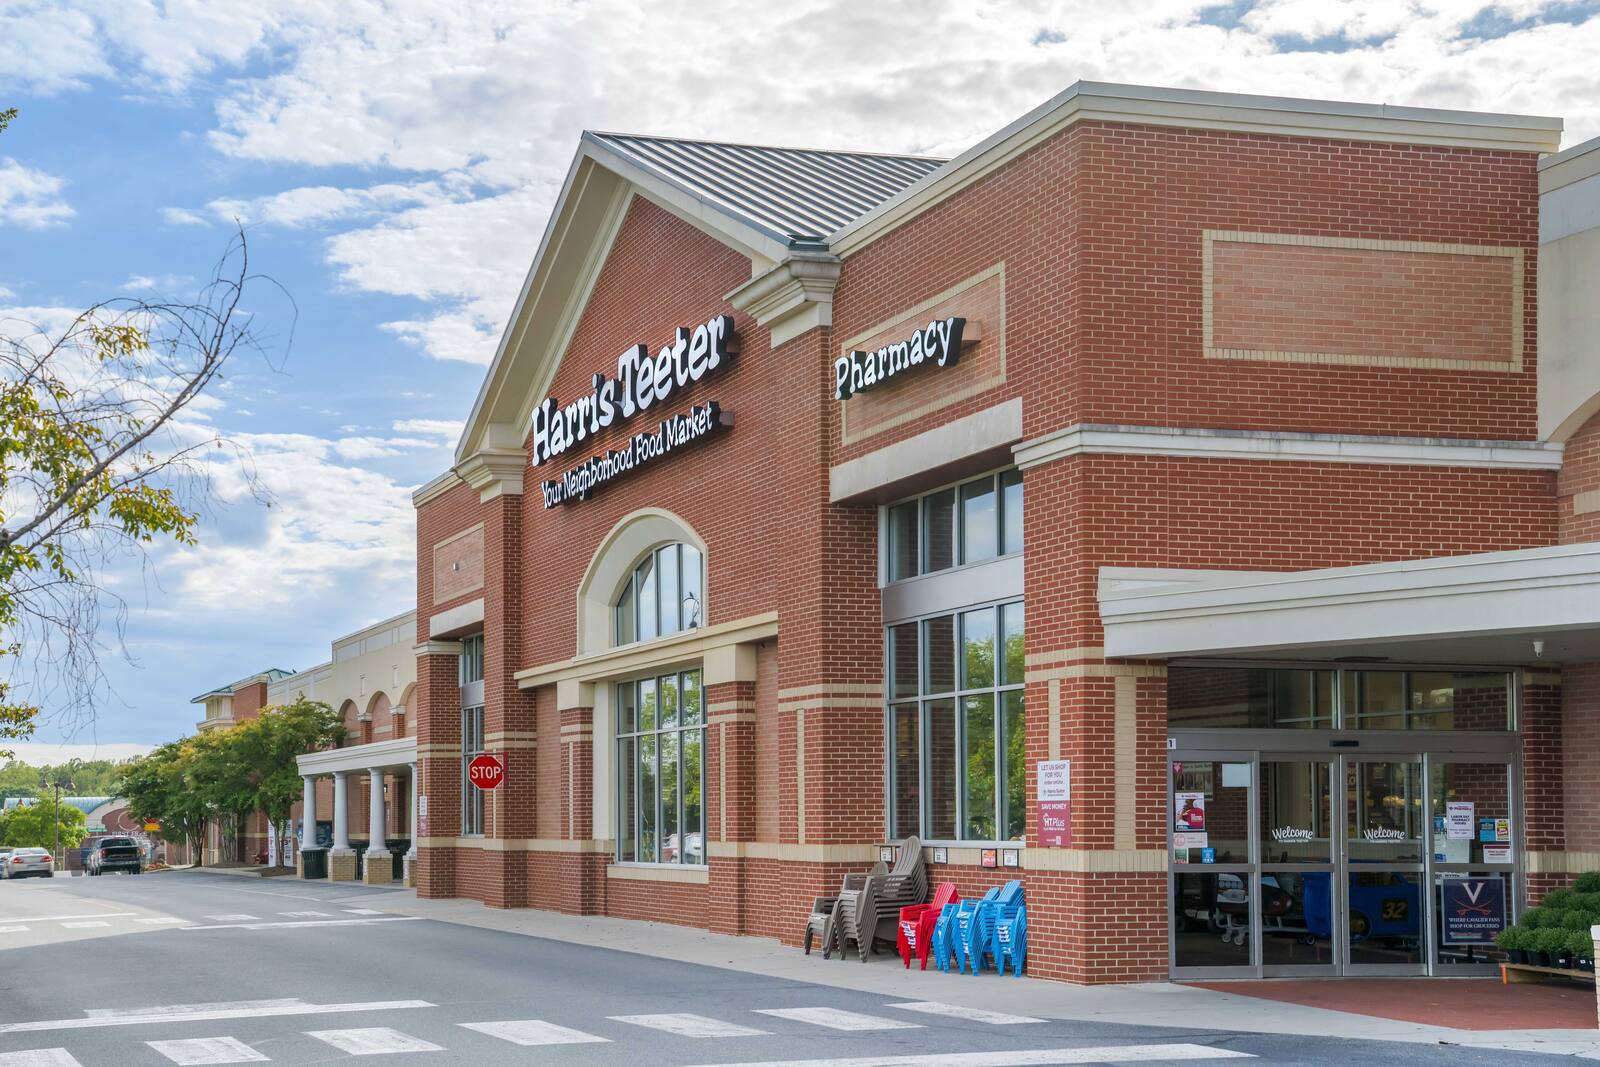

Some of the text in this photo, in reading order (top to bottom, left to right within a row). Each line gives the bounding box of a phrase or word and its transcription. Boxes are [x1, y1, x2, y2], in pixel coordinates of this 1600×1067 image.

[834, 318, 955, 399] Pharmacy
[531, 314, 726, 467] Harris Teeter
[540, 404, 713, 509] Your Neighborhood Food Market
[1168, 739, 1173, 748] 1
[471, 766, 501, 779] STOP
[1271, 825, 1313, 840] Welcome
[1363, 826, 1405, 840] Welcome
[1383, 902, 1408, 919] 32
